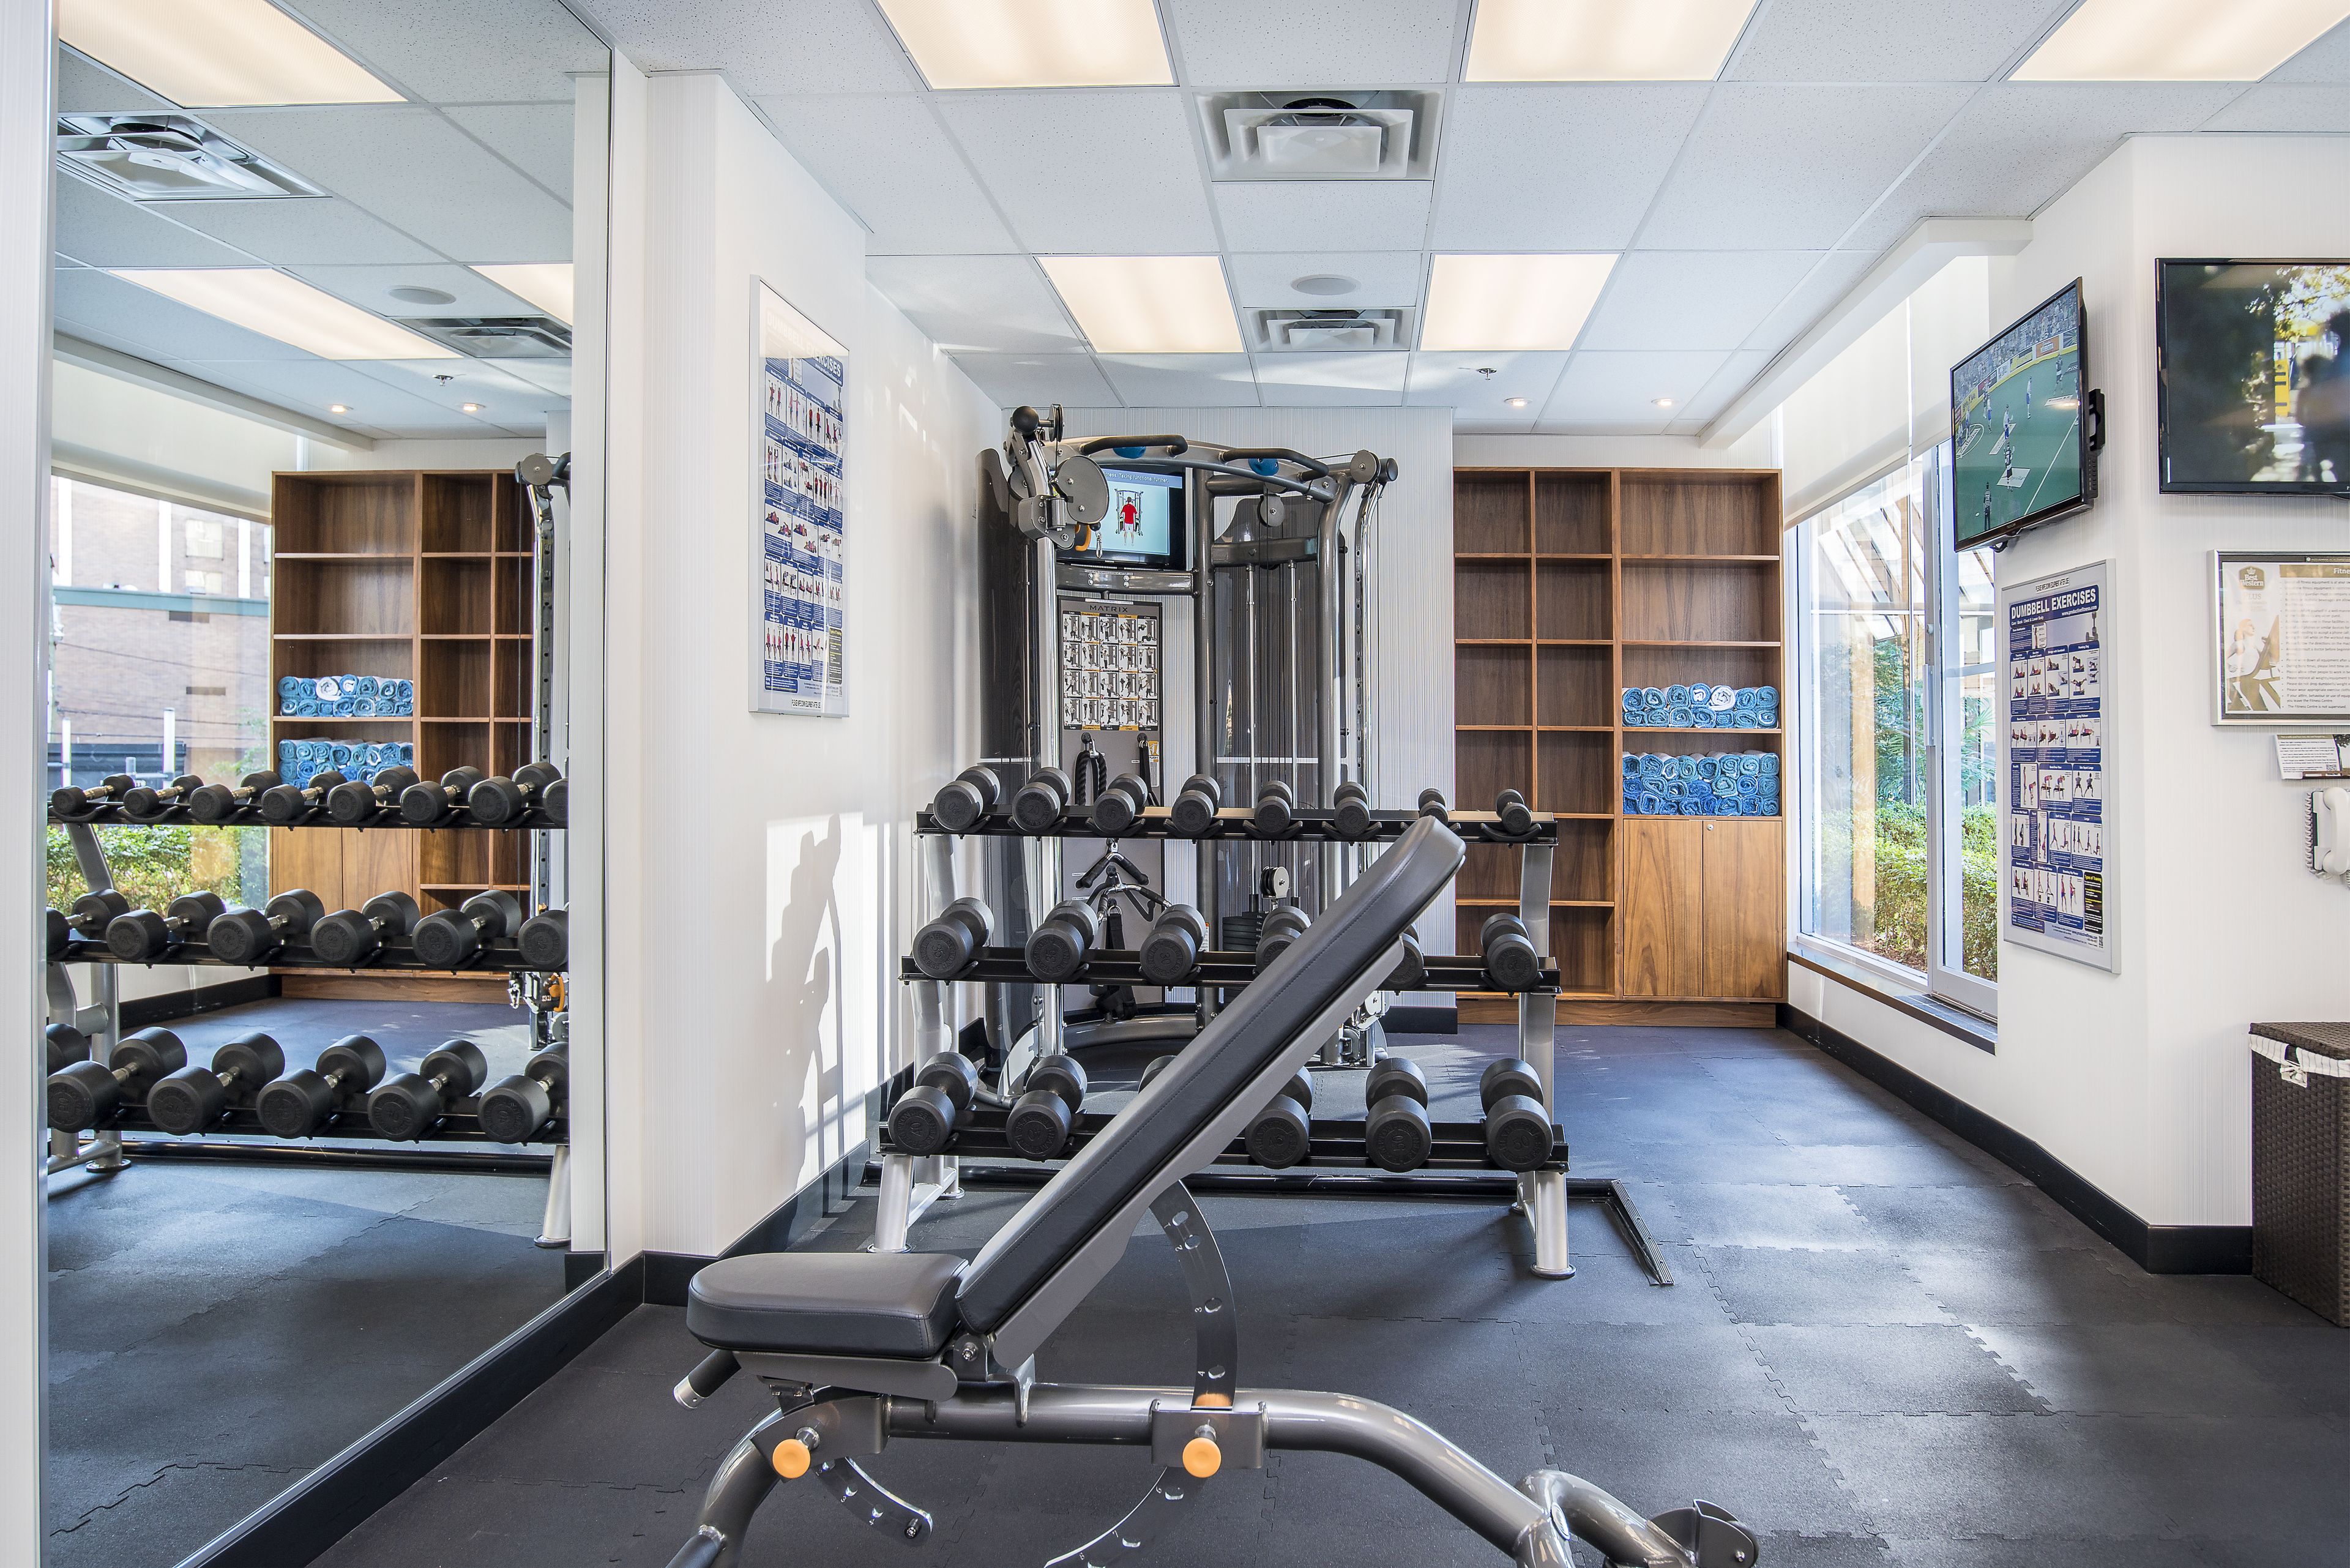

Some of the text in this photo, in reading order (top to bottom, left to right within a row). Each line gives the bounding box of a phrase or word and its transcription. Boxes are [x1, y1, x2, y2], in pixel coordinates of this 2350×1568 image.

[806, 340, 841, 378] EXERCISES
[2011, 588, 2096, 619] DUMBBELL EXERCISES
[1112, 1529, 1119, 1538] 7
[1079, 1552, 1085, 1561] 8
